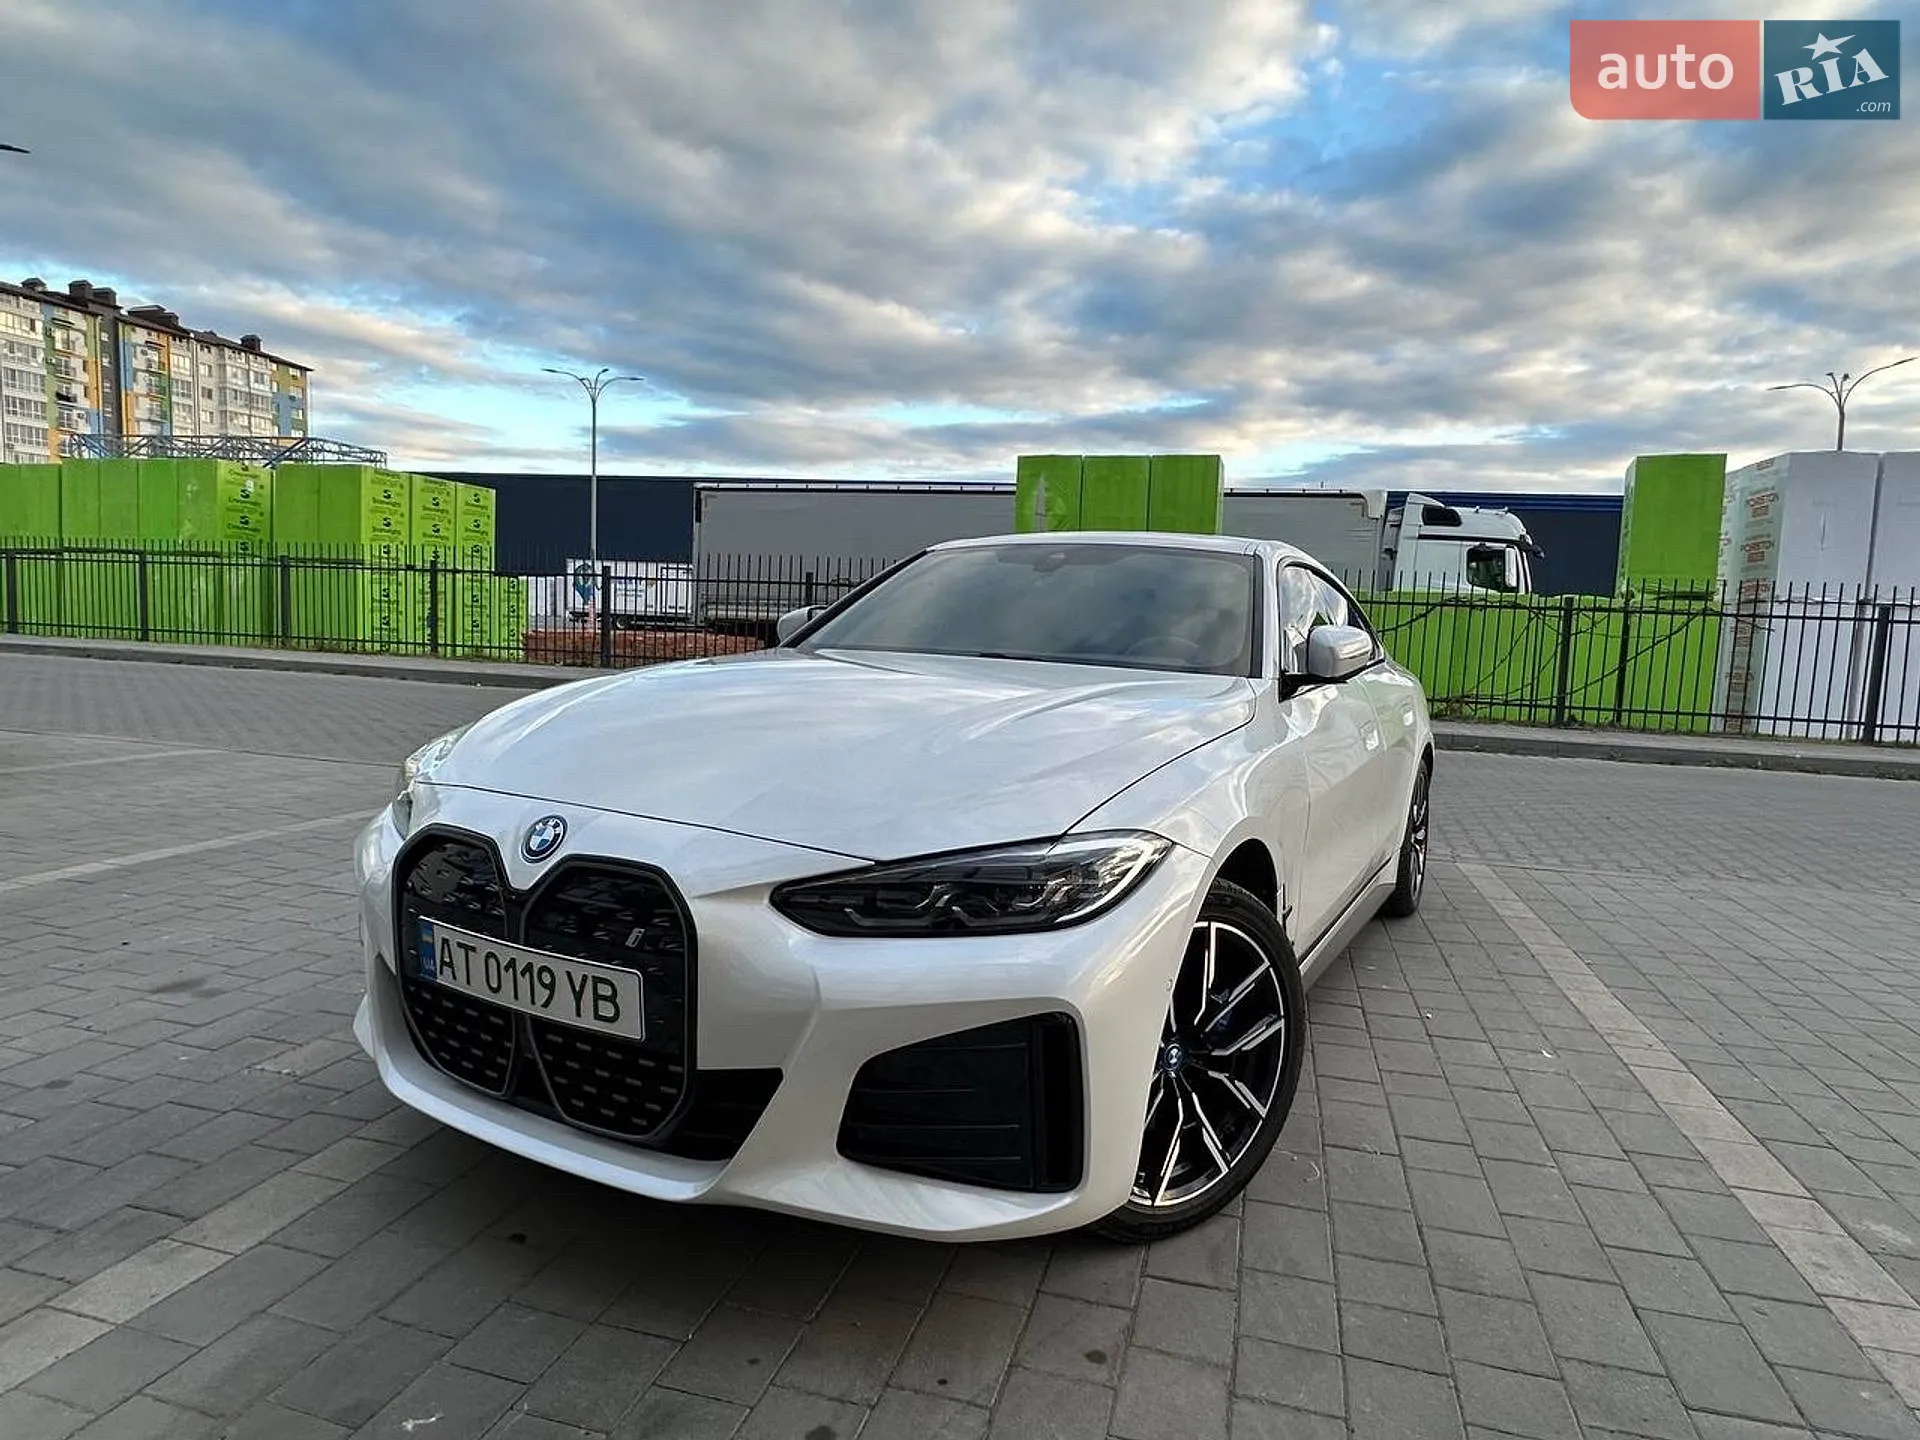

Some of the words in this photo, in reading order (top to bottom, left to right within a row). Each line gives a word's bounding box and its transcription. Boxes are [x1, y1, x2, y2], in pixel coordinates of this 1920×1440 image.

[437, 937, 477, 987] AT
[484, 953, 557, 1009] 0119
[565, 970, 621, 1024] YB
